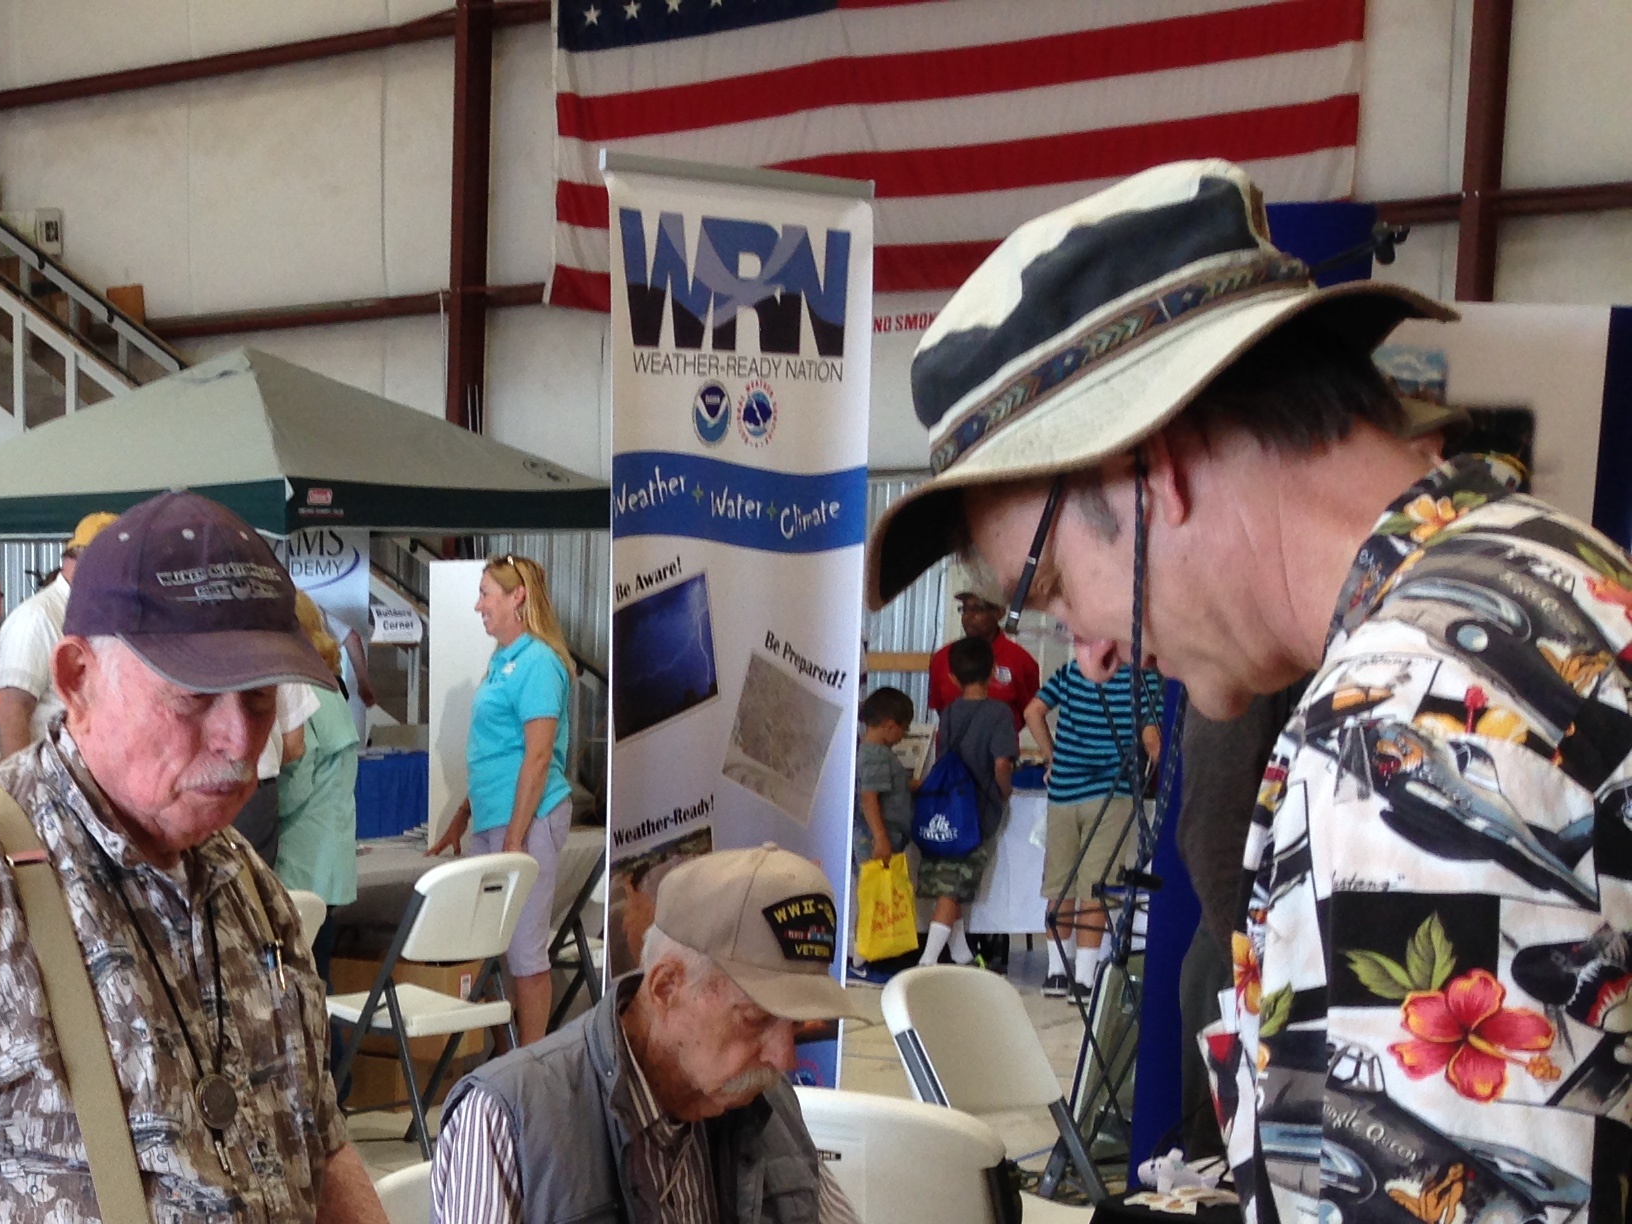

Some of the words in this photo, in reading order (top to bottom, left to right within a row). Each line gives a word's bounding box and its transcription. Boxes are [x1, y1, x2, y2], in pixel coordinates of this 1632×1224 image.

[619, 207, 850, 358] WRN
[874, 315, 891, 333] NO
[633, 351, 781, 379] WEATHER-READY
[786, 357, 843, 382] NATION
[613, 466, 687, 520] Weather
[711, 487, 763, 519] Water
[780, 498, 841, 539] Climate
[615, 581, 632, 602] Be
[635, 555, 683, 595] Aware!
[765, 630, 783, 653] Be
[784, 641, 847, 690] Prepared!
[614, 795, 715, 848] Weather-Ready!
[1366, 1122, 1417, 1163] Queen
